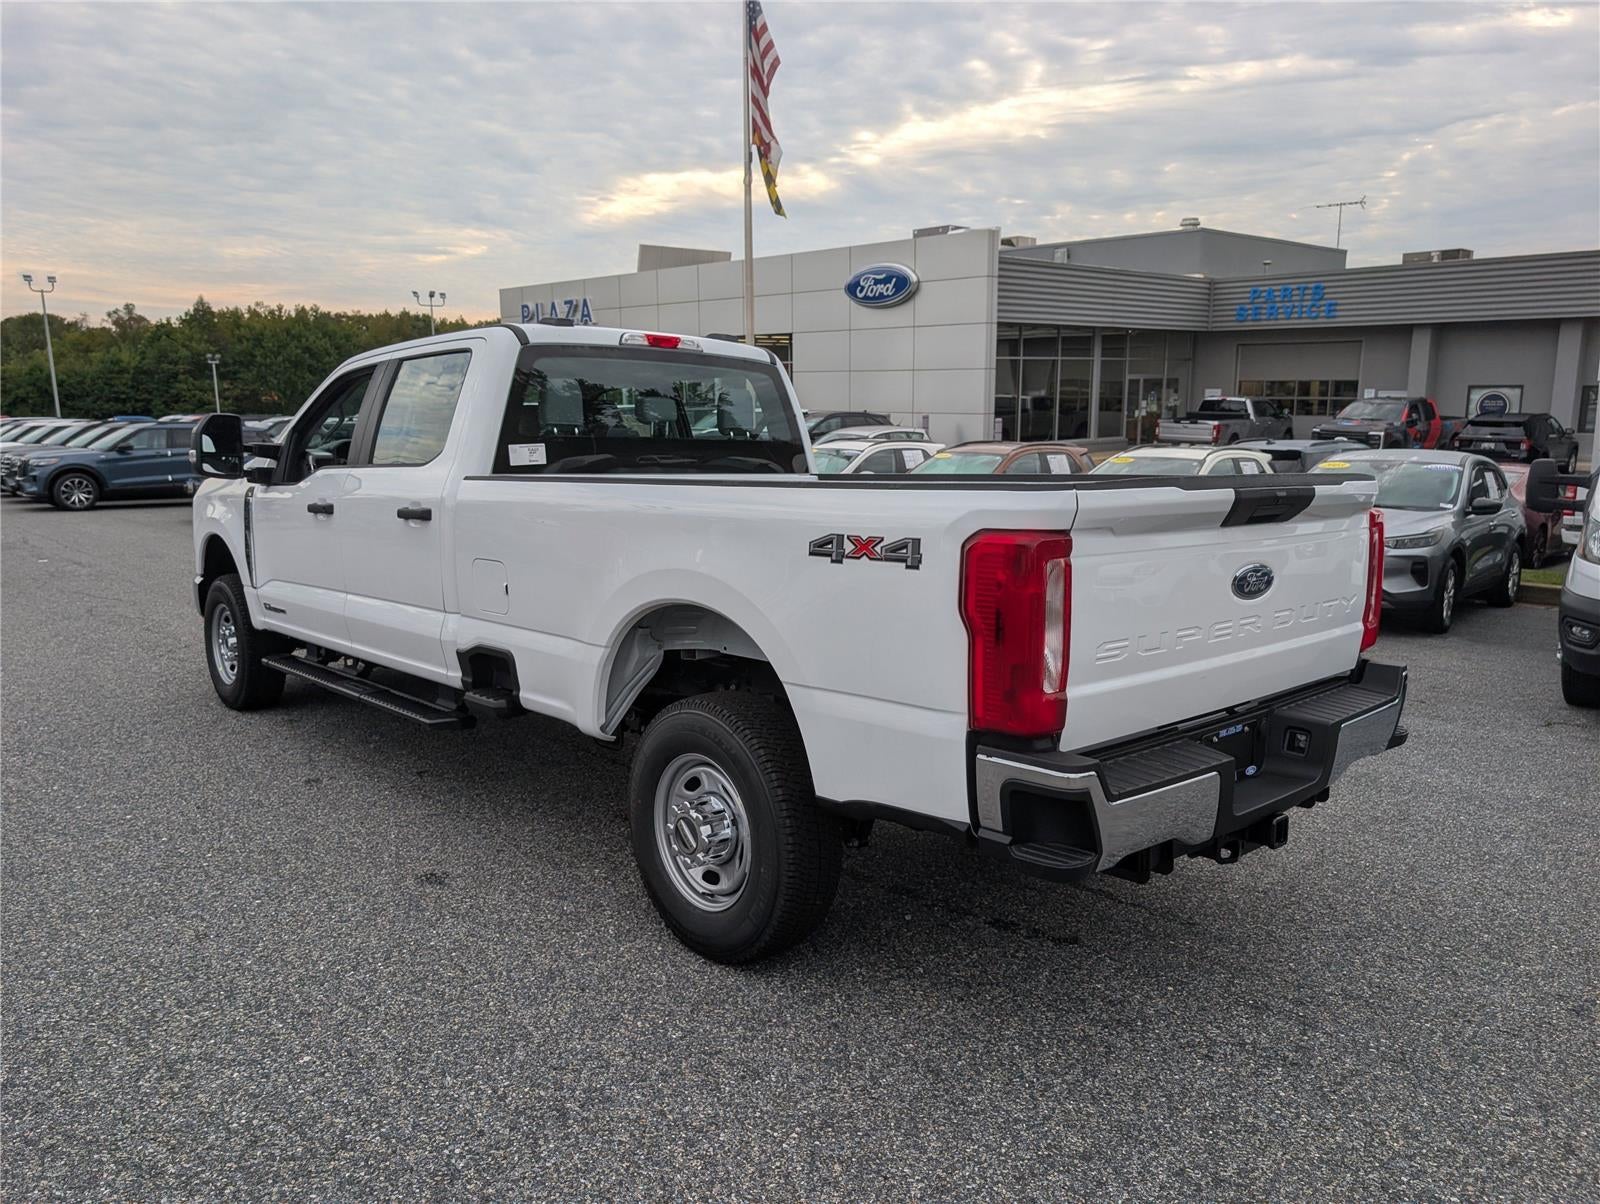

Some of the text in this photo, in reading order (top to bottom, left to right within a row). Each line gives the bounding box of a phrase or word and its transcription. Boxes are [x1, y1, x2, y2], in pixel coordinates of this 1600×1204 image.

[856, 273, 896, 298] Ford
[1249, 283, 1325, 303] PARTS
[1235, 301, 1338, 321] SERVICE
[1243, 571, 1268, 592] Ford
[1095, 594, 1358, 665] SUPER DUTY
